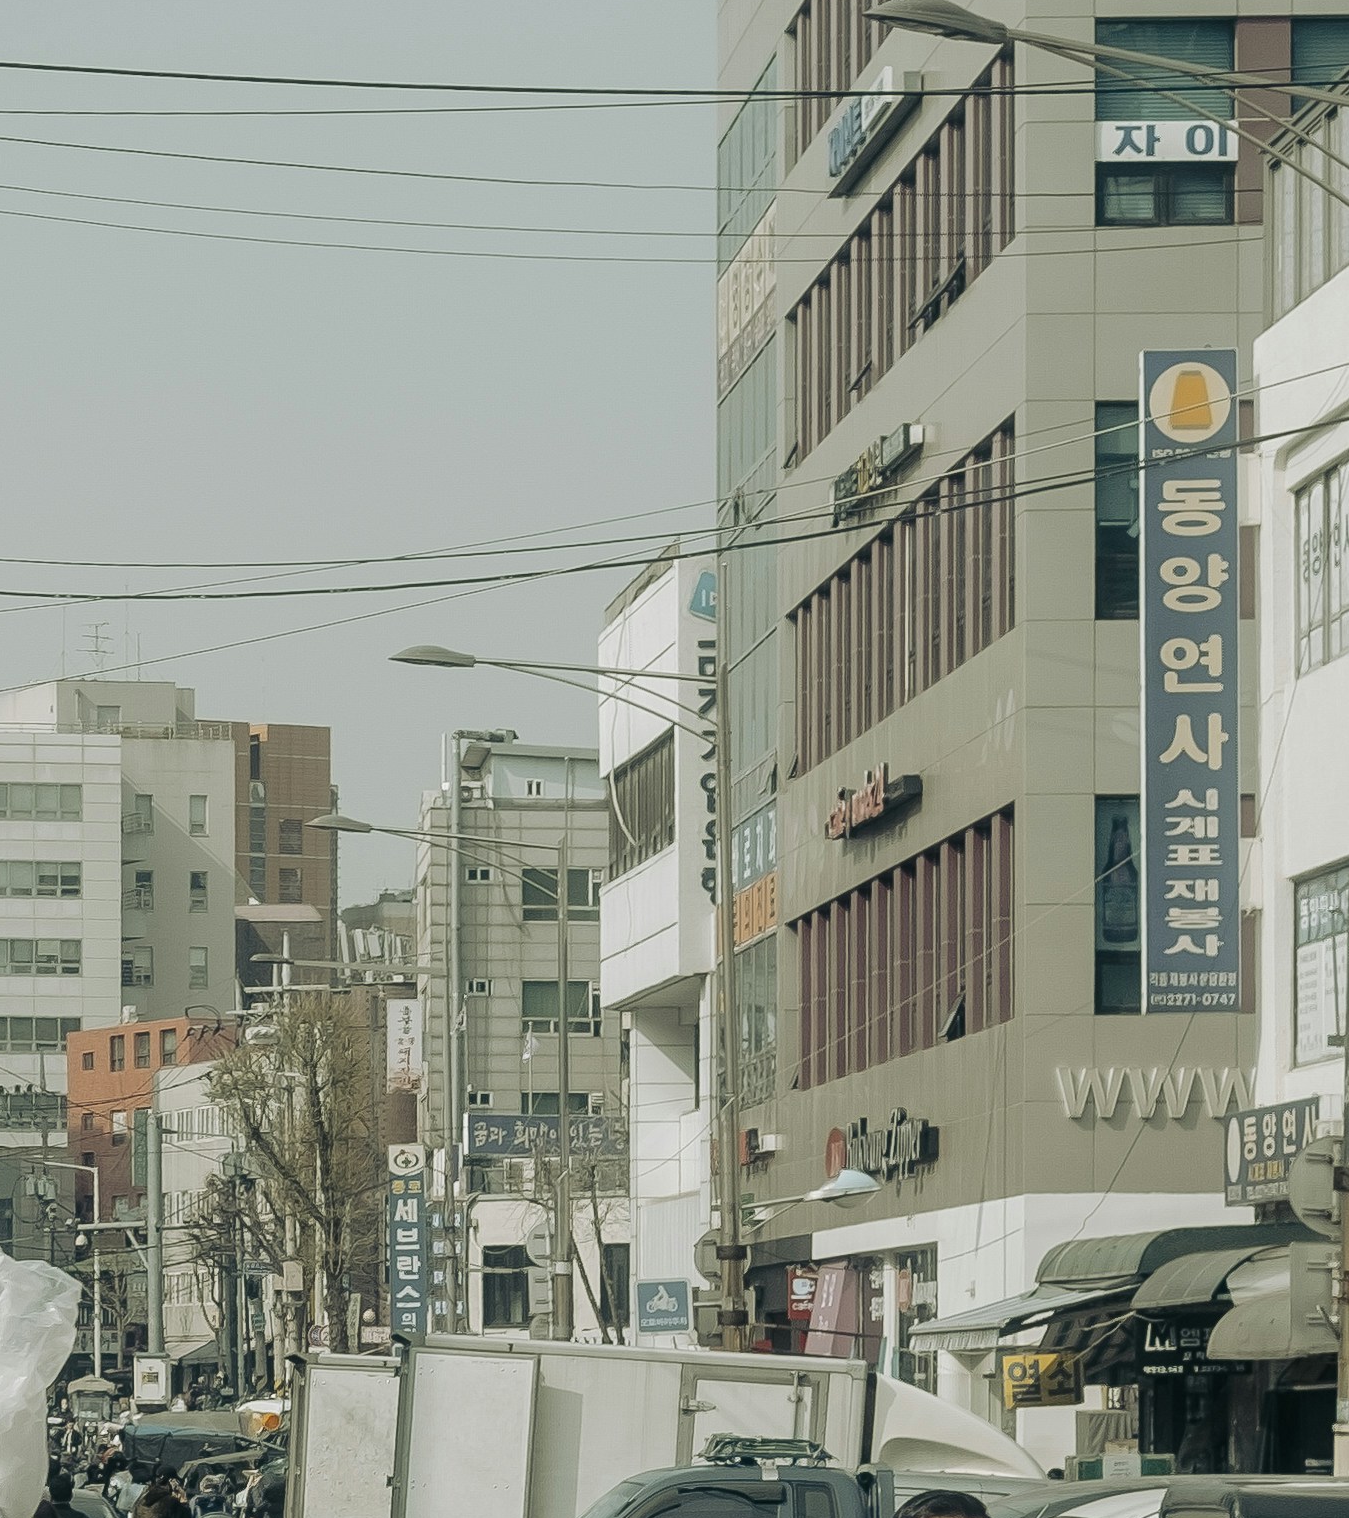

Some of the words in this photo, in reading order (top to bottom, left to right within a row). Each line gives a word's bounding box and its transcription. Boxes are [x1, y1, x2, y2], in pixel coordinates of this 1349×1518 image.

[1112, 124, 1230, 159] 자이
[1157, 478, 1231, 773] 동양연사
[1163, 787, 1224, 867] 시계표
[1162, 878, 1225, 959] 재봉사
[393, 1197, 423, 1333] 세브란스의
